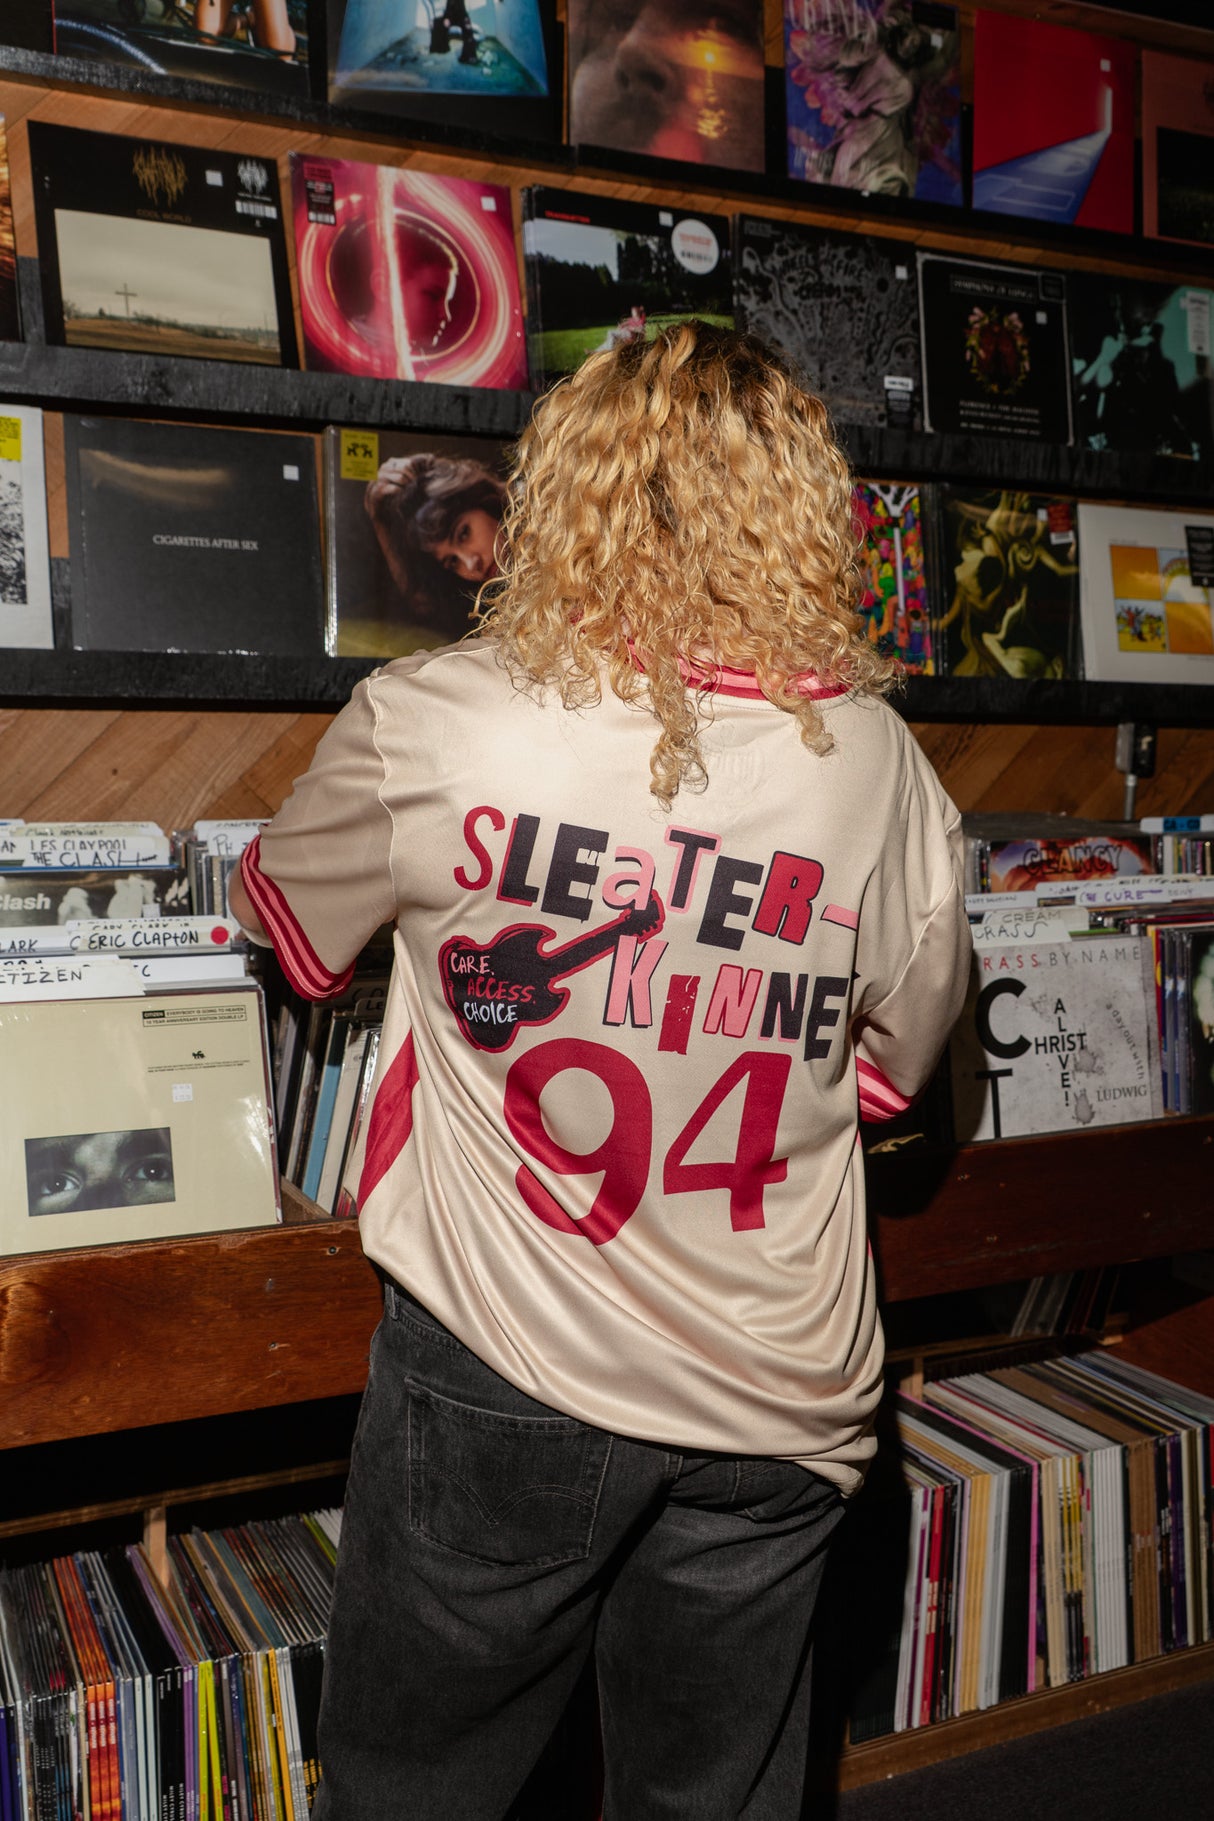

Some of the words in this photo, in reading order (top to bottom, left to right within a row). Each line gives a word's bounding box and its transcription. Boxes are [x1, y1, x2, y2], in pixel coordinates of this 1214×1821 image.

[31, 852, 52, 867] THE
[59, 851, 140, 867] CLASH
[1023, 845, 1122, 876] CLANCY
[0, 893, 51, 911] lash
[974, 920, 1049, 941] CRASS
[88, 933, 126, 950] ERIC
[1049, 951, 1071, 967] BY
[1082, 946, 1142, 963] NAME
[464, 1003, 519, 1025] CHOICE
[1096, 1085, 1148, 1102] LUDWIG
[504, 1038, 792, 1247] 94
